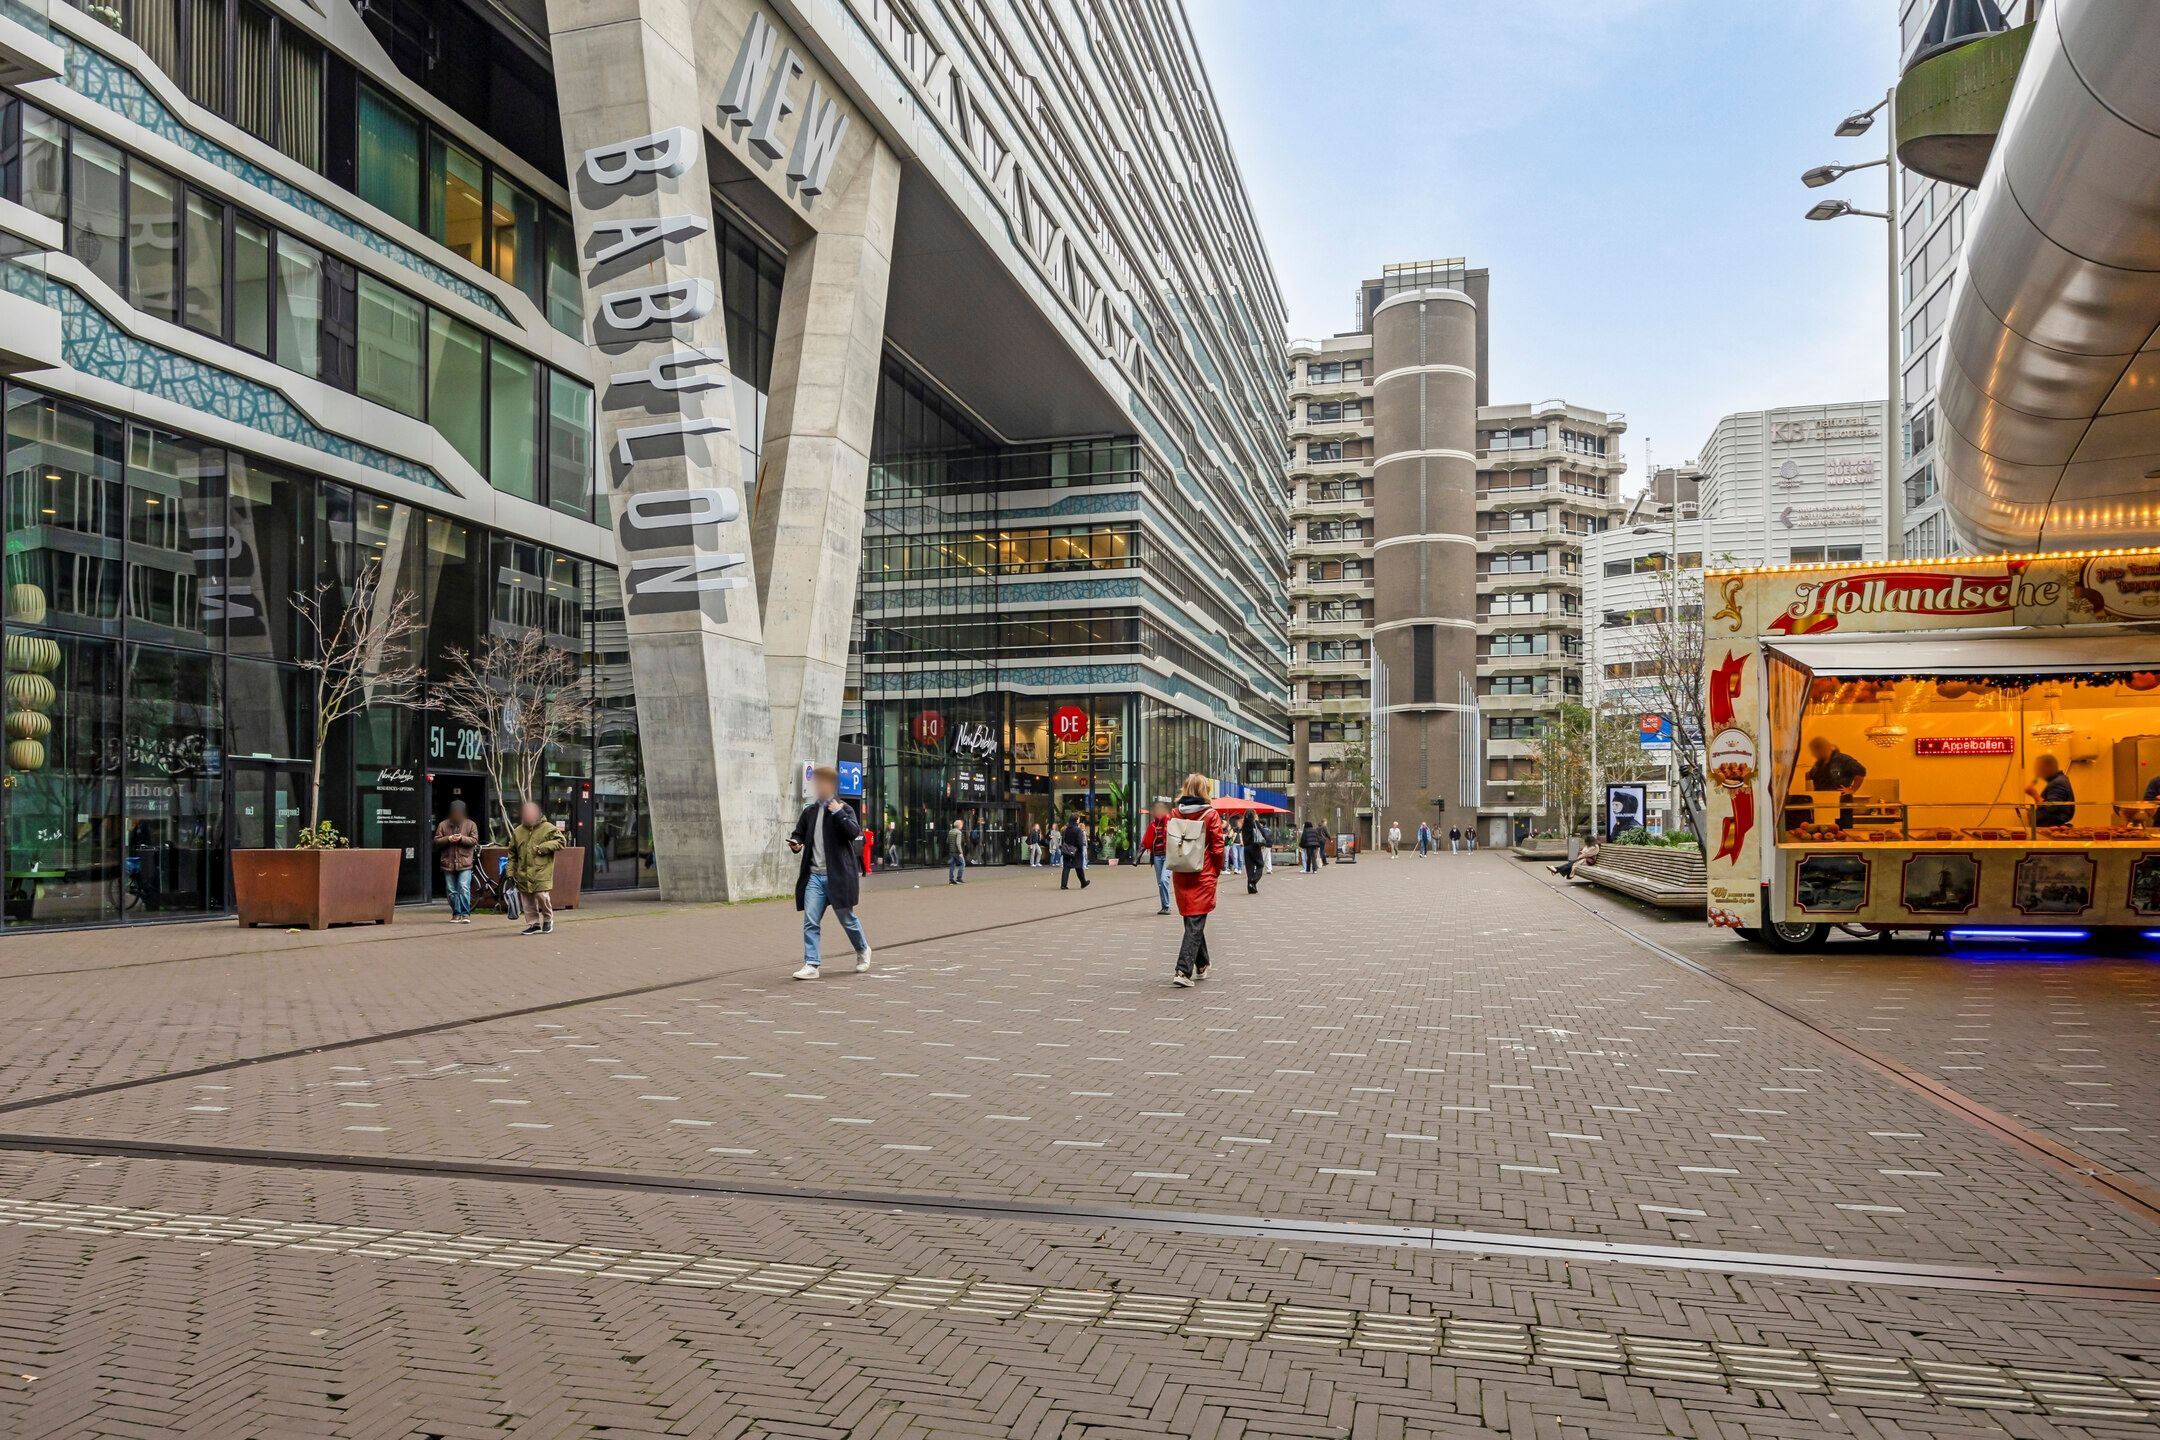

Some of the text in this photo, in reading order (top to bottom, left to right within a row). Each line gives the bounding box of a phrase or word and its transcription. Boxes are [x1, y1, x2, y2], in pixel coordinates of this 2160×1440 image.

[718, 11, 849, 196] NEW
[585, 125, 750, 597] BABYLON
[1827, 475, 1873, 486] MUSEUM
[1787, 574, 2060, 619] Hollandsche
[1942, 740, 2005, 752] Appelbollen
